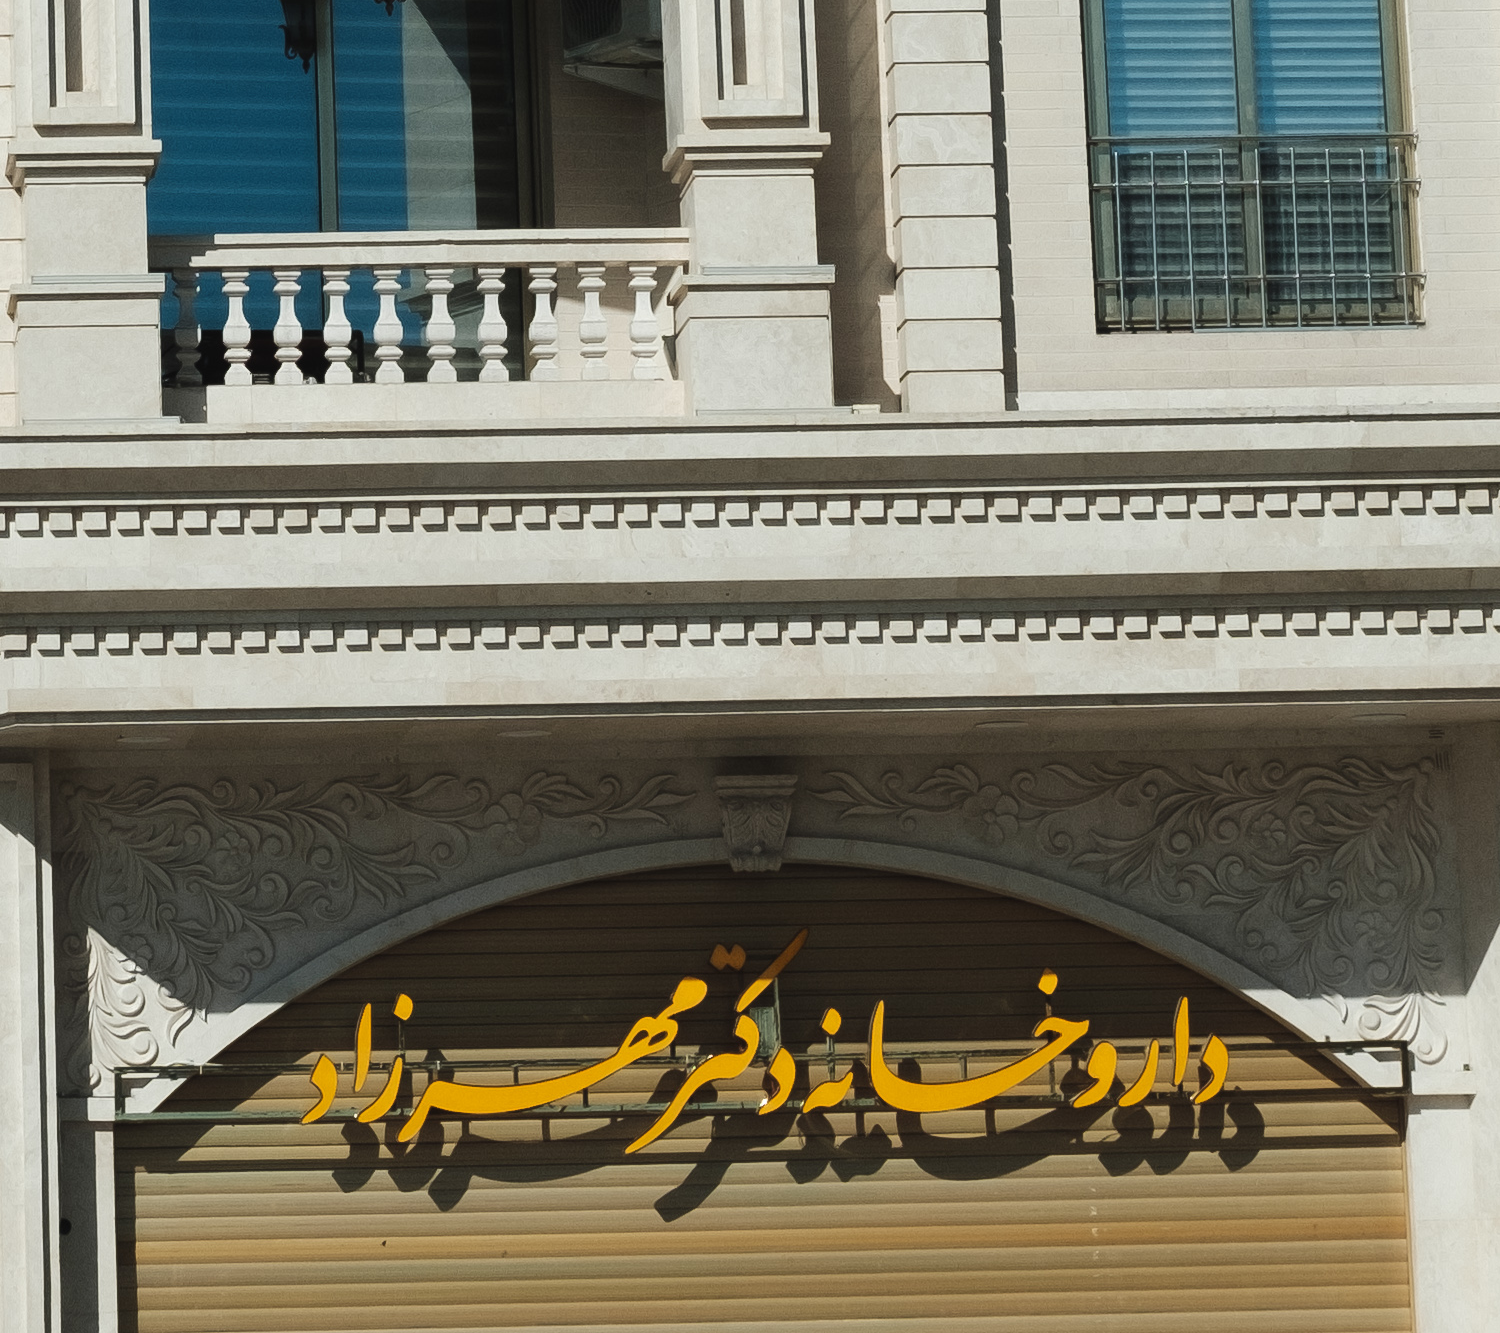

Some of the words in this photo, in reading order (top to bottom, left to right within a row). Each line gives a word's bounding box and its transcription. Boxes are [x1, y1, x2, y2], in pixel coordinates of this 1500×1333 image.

[300, 975, 709, 1144] مهرزاد
[623, 928, 809, 1155] دکتر
[802, 967, 1229, 1115] داروخانه
